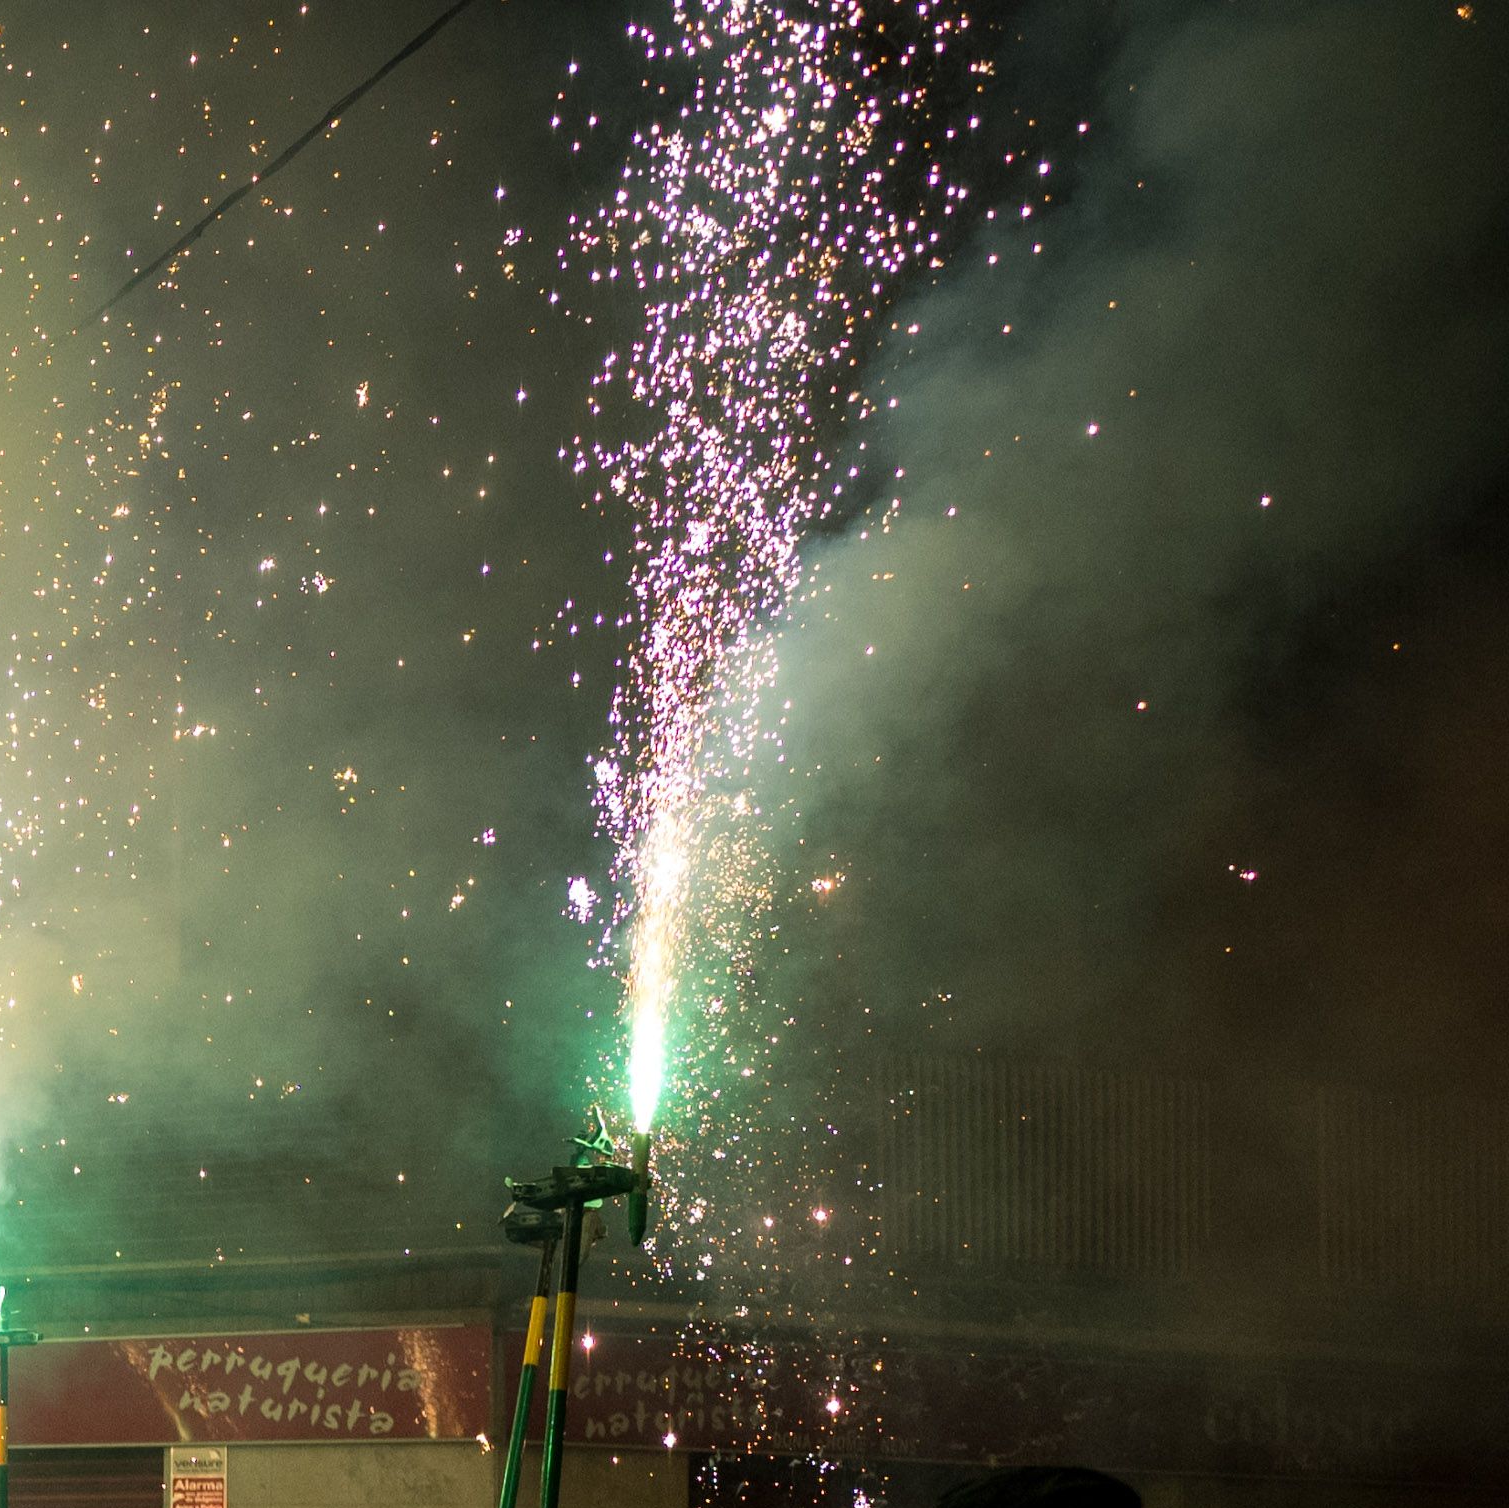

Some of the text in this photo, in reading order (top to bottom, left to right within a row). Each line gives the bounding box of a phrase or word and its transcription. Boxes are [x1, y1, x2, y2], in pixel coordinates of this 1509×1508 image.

[148, 1344, 421, 1395] perruqueria
[179, 1384, 394, 1435] naturista
[174, 1479, 223, 1491] Alarma
